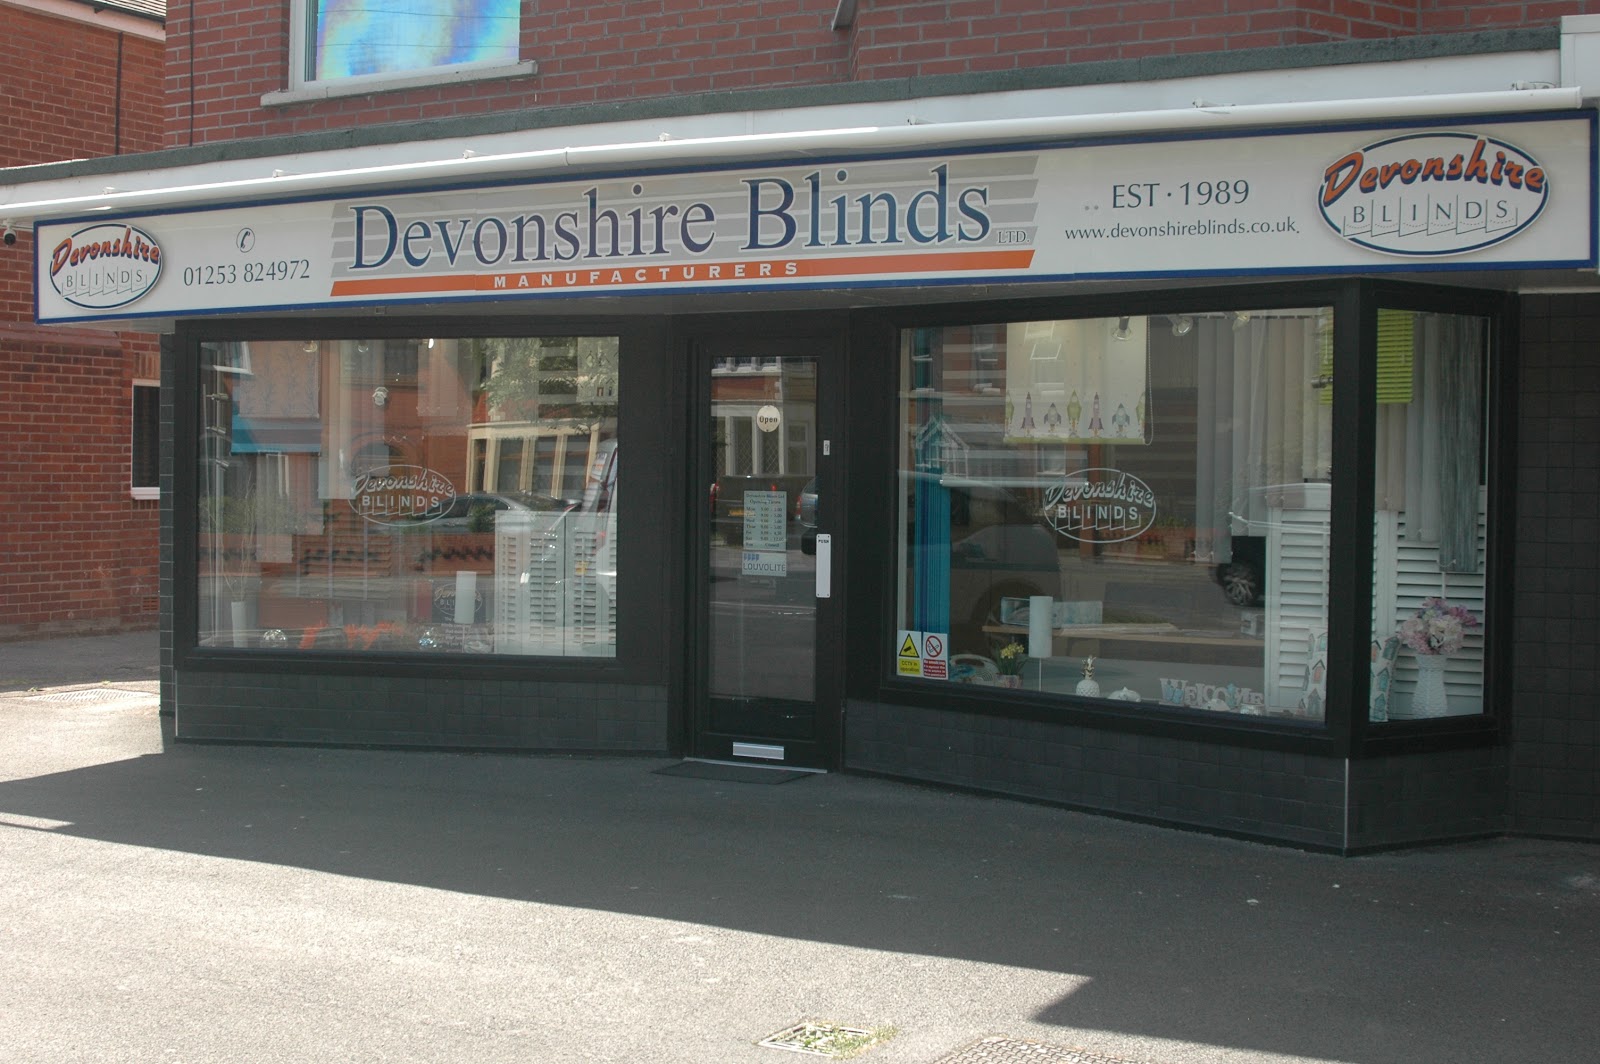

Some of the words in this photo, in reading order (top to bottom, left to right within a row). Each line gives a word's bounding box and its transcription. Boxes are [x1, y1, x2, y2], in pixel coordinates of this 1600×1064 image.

[1323, 139, 1545, 208] Devonshire
[348, 185, 717, 270] Devonshire
[740, 163, 991, 252] Blinds
[1352, 200, 1508, 224] BLINDS
[52, 228, 160, 277] Devonshire
[66, 269, 144, 288] BLINDS
[183, 264, 237, 286] 01253
[243, 259, 310, 283] 824972
[493, 262, 798, 289] MANUFACTURERS
[758, 415, 779, 425] Open
[352, 468, 456, 498] Devonshire
[1045, 472, 1155, 511] Devonshire
[361, 495, 440, 508] BLINDS
[1057, 505, 1139, 520] BLINDS
[743, 563, 786, 571] LOUVOLITE
